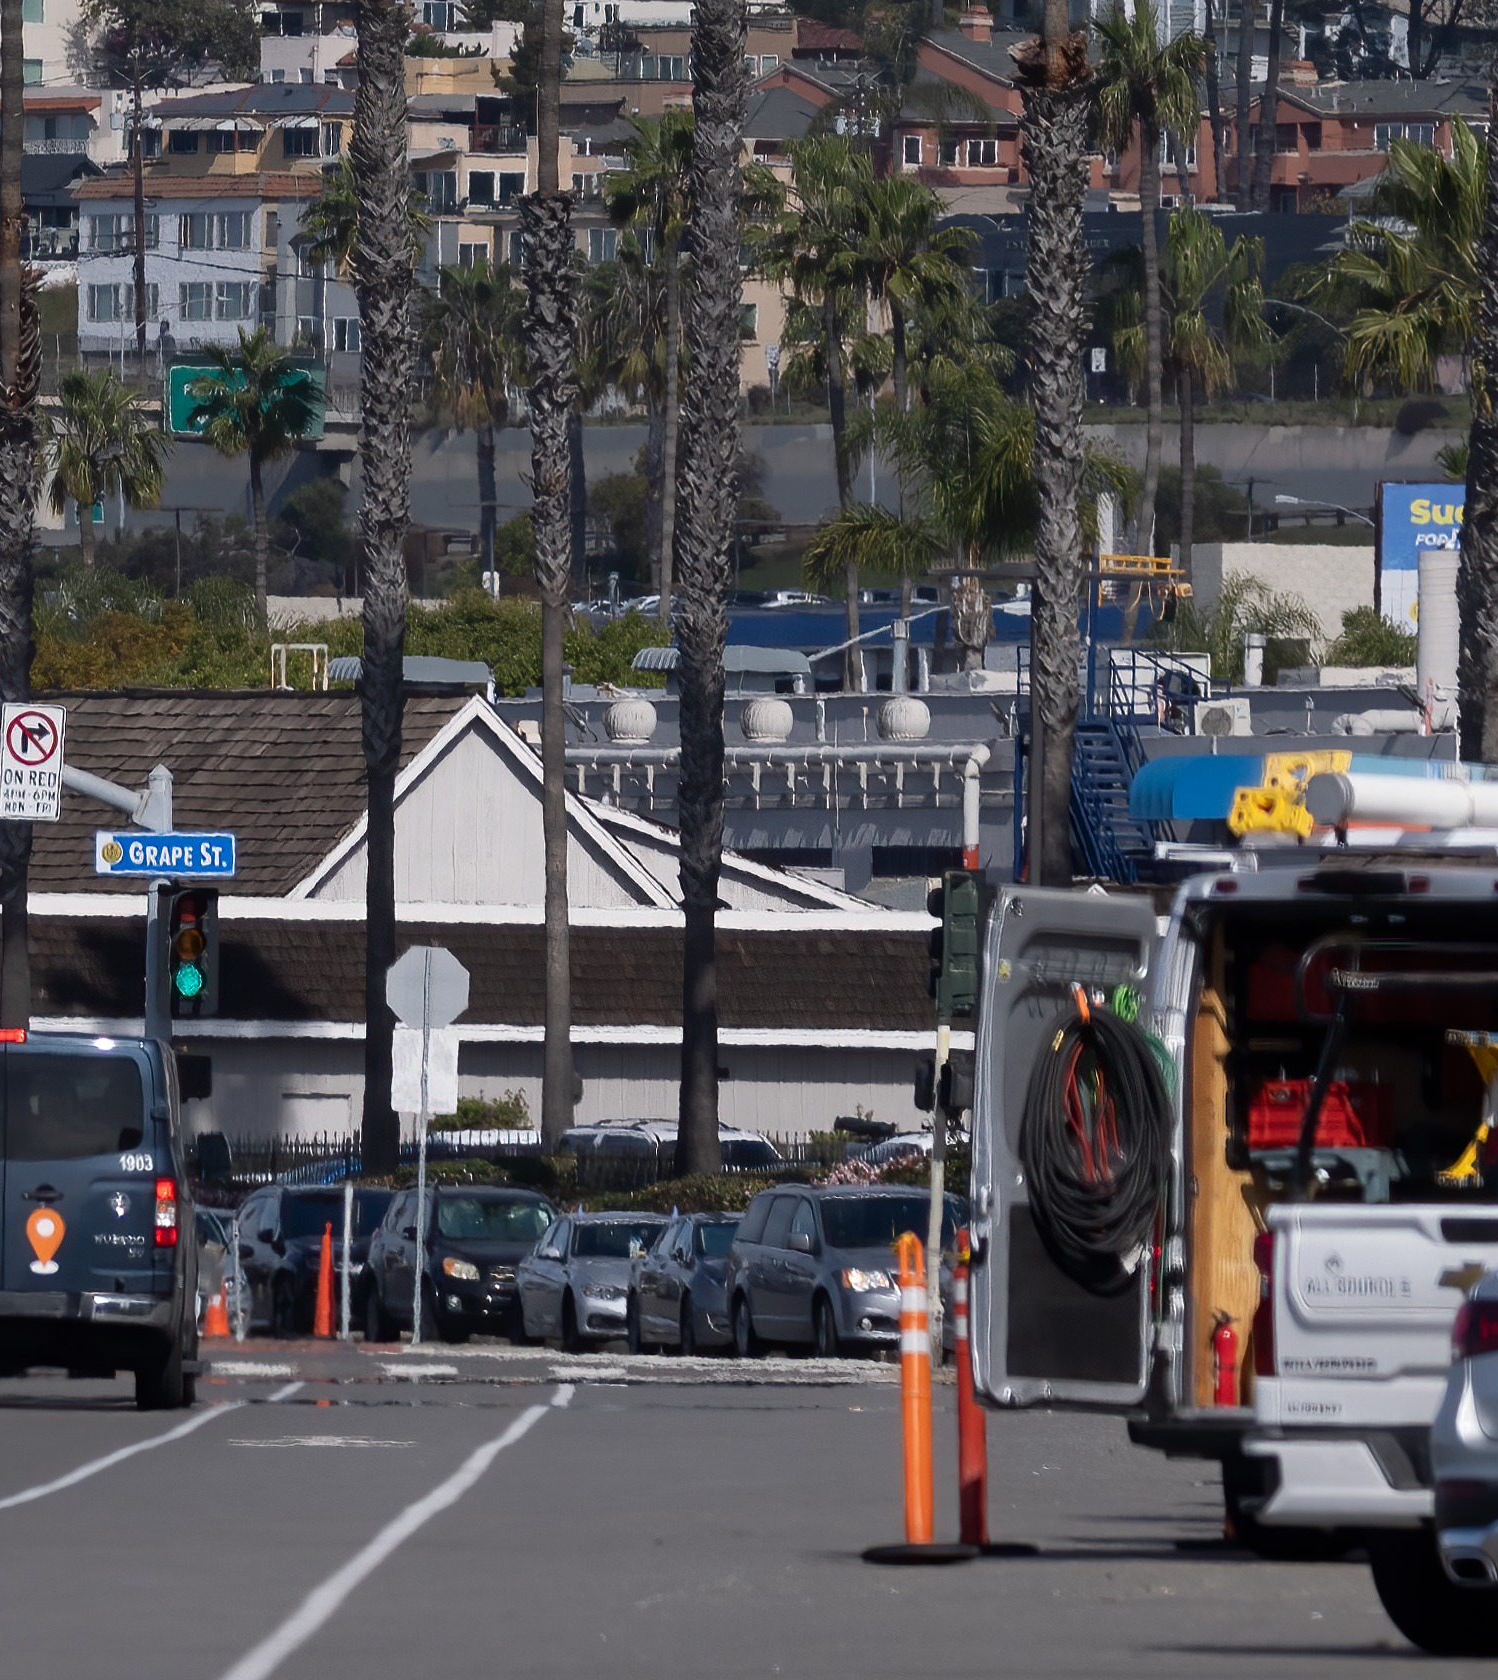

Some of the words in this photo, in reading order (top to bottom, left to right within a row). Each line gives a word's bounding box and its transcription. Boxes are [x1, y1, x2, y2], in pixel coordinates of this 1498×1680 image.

[4, 768, 24, 785] ON
[29, 770, 57, 788] RED
[4, 801, 25, 813] MON
[129, 840, 194, 867] GRAPE
[200, 841, 228, 868] ST.
[118, 1153, 154, 1172] 1903
